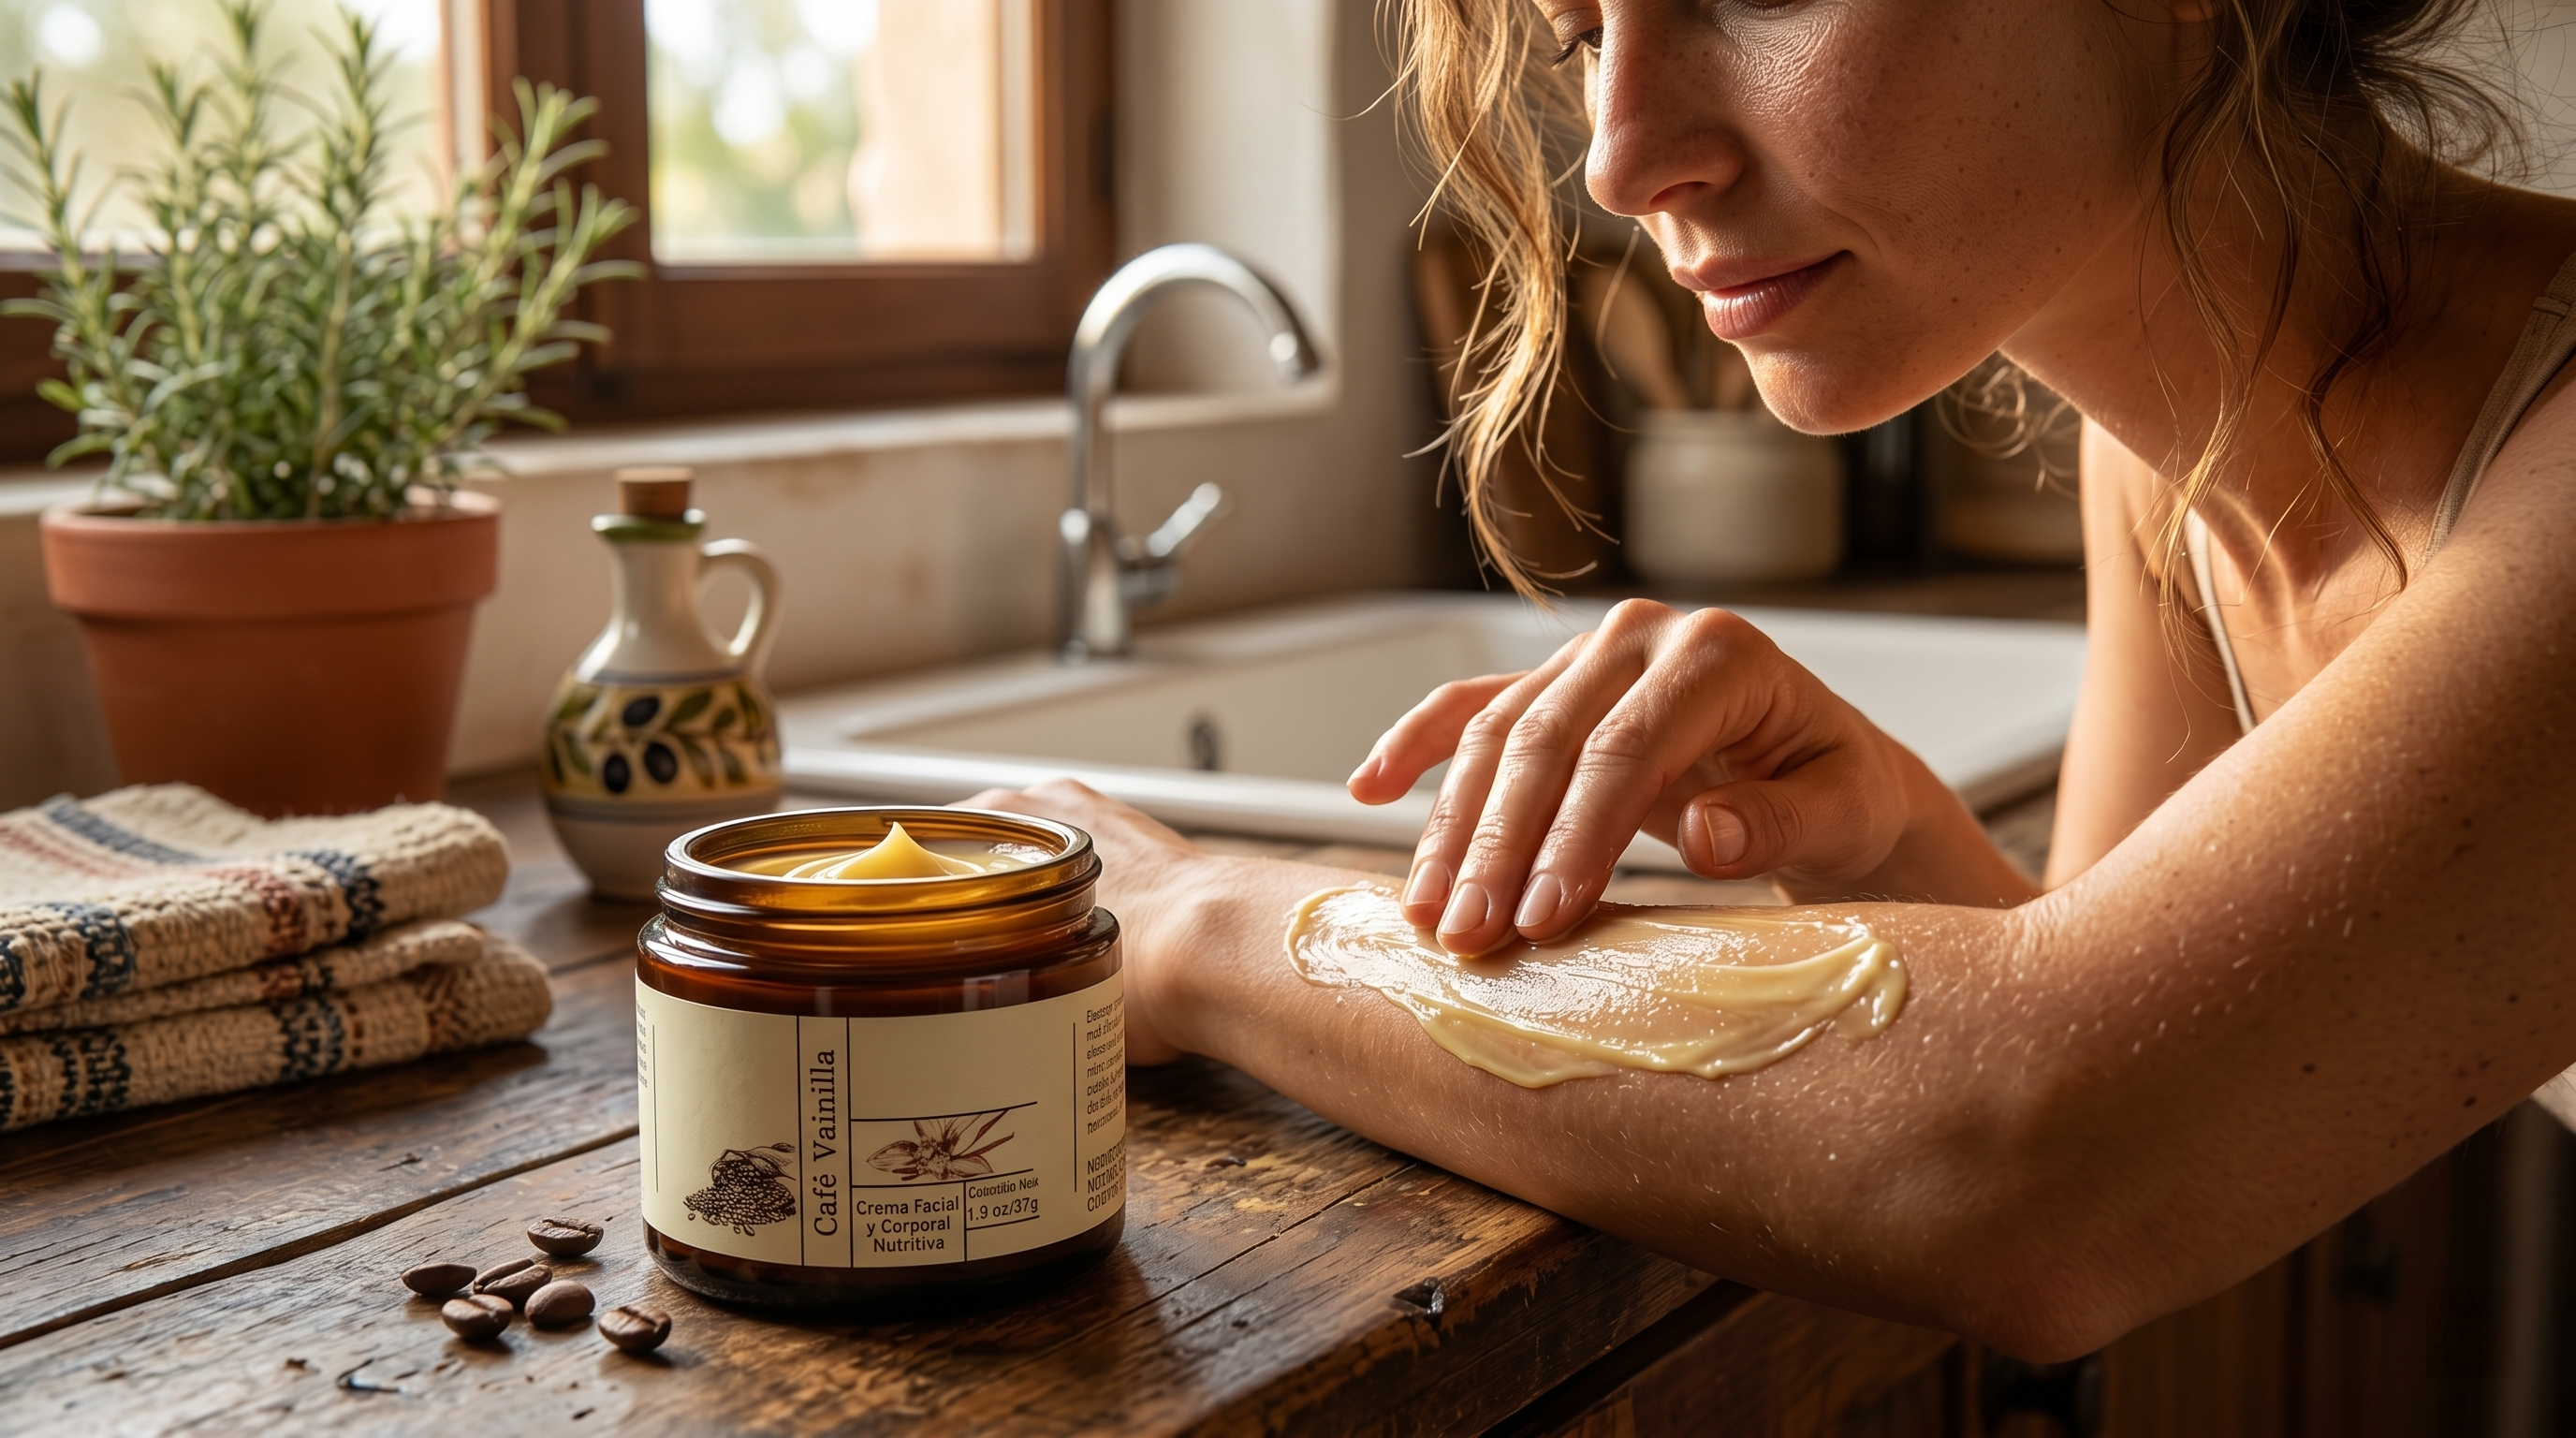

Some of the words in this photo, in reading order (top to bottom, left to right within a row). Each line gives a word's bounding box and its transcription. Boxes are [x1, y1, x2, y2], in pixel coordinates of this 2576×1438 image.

[810, 1049, 836, 1162] Vainilla
[856, 1200, 909, 1215] Crema
[915, 1196, 959, 1213] Facial
[967, 1205, 988, 1221] 1.9
[992, 1196, 1038, 1217] oz/37g
[866, 1223, 876, 1238] y
[881, 1215, 950, 1236] Corporal
[873, 1236, 944, 1253] Nutritiva
